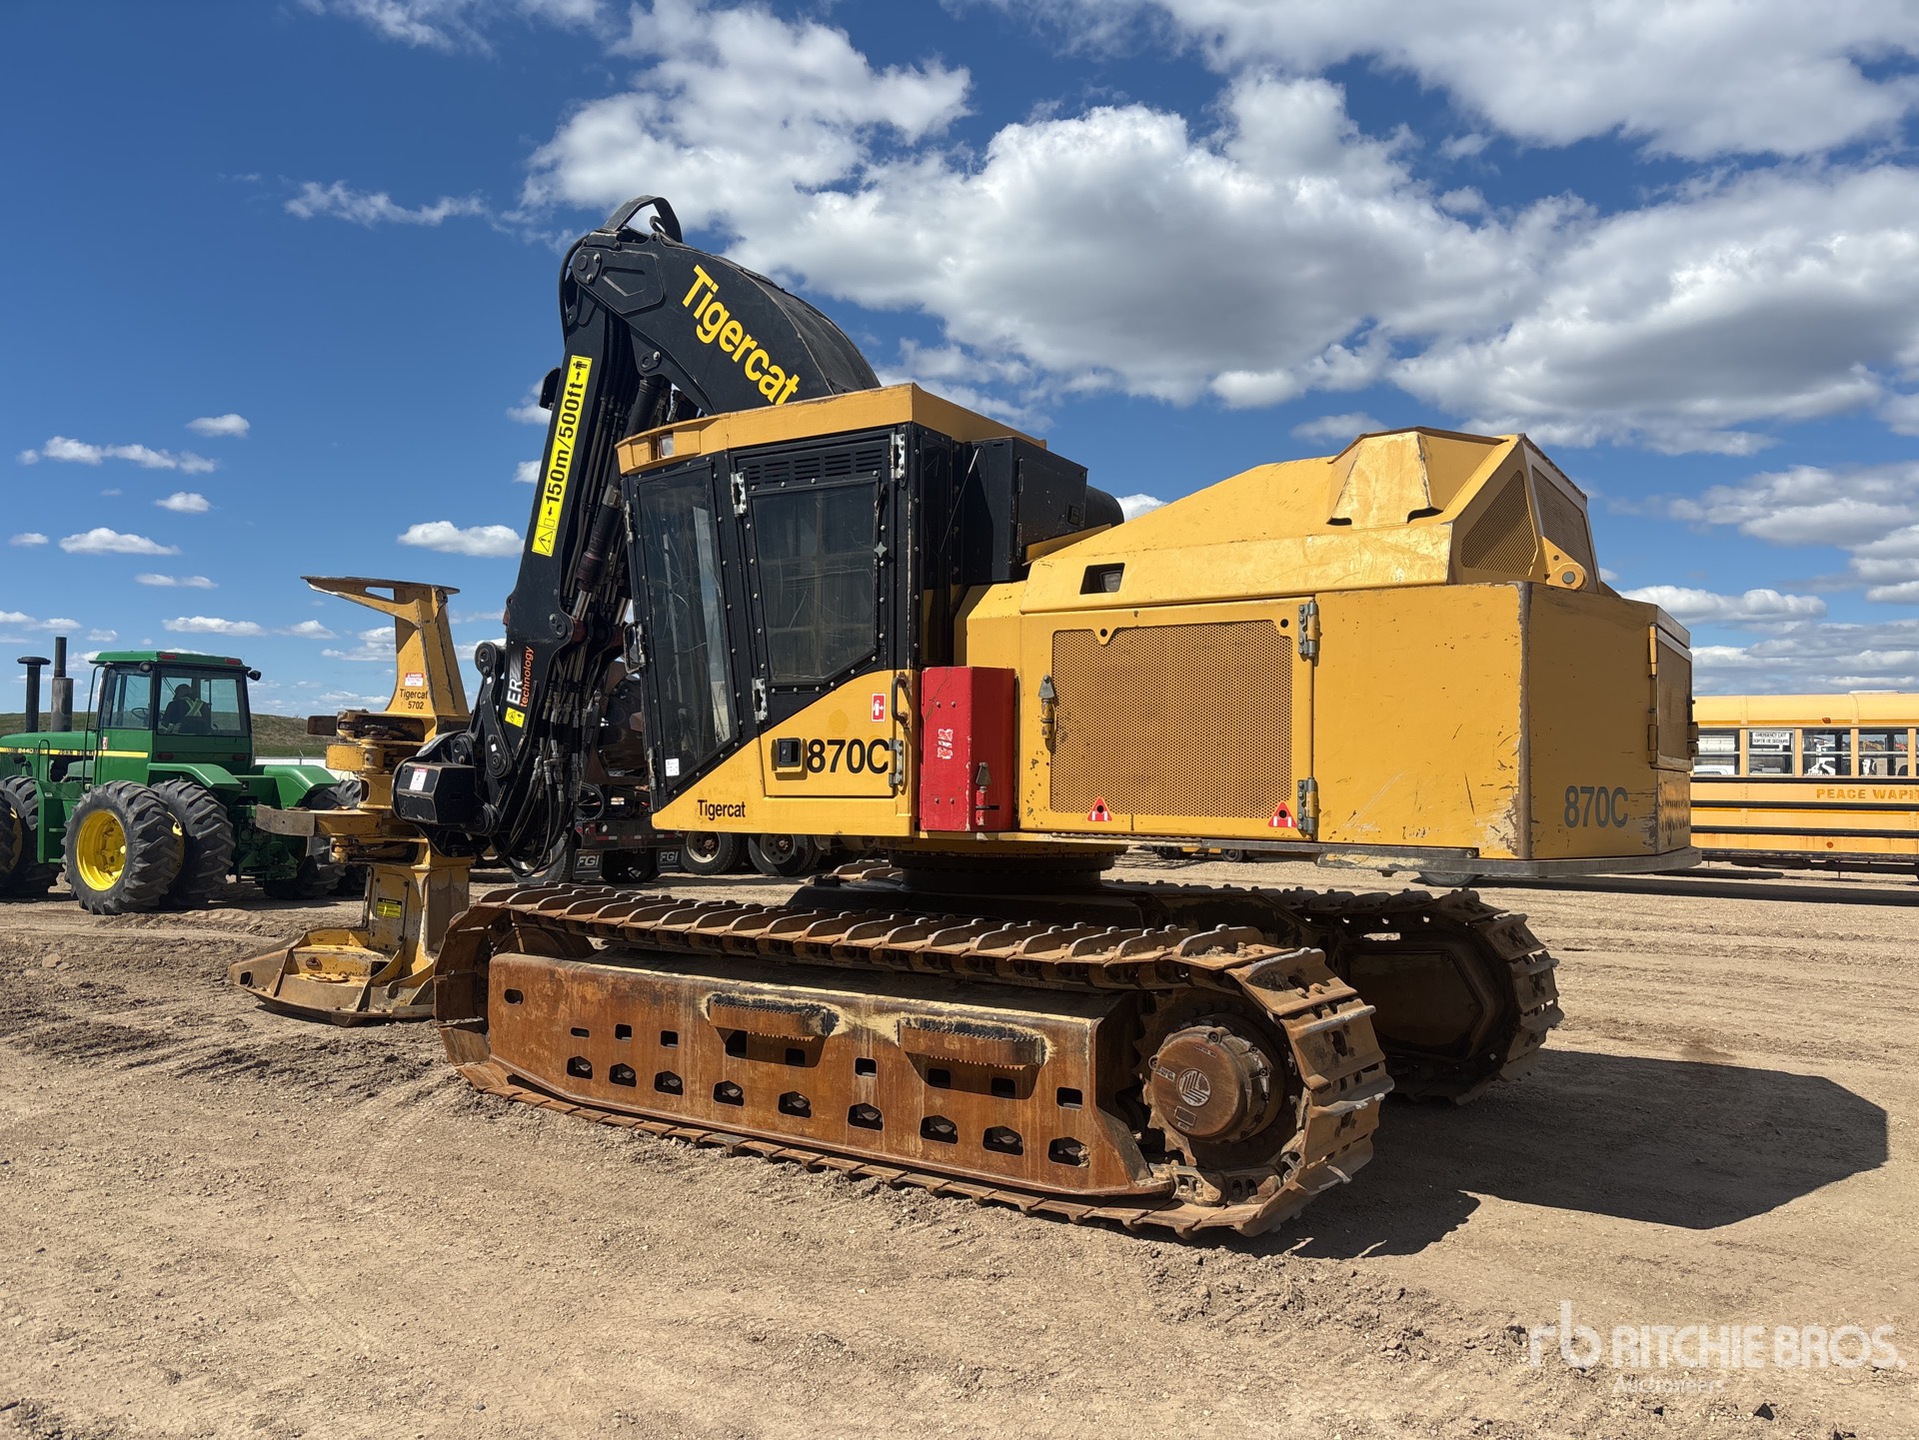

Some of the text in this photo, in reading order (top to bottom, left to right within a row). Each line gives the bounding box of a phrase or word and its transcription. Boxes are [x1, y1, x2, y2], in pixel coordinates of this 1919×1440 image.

[682, 264, 800, 405] Tigercat
[546, 382, 583, 503] 150m/500ft
[520, 645, 535, 707] technology
[400, 689, 428, 700] Tigercat
[506, 678, 523, 705] ER
[407, 701, 424, 709] 5702
[806, 738, 889, 774] 870C
[1816, 788, 1867, 799] PEACE
[697, 799, 746, 820] Tigercat
[1564, 785, 1629, 828] 870C
[577, 855, 600, 867] FGI
[660, 851, 679, 862] FGI
